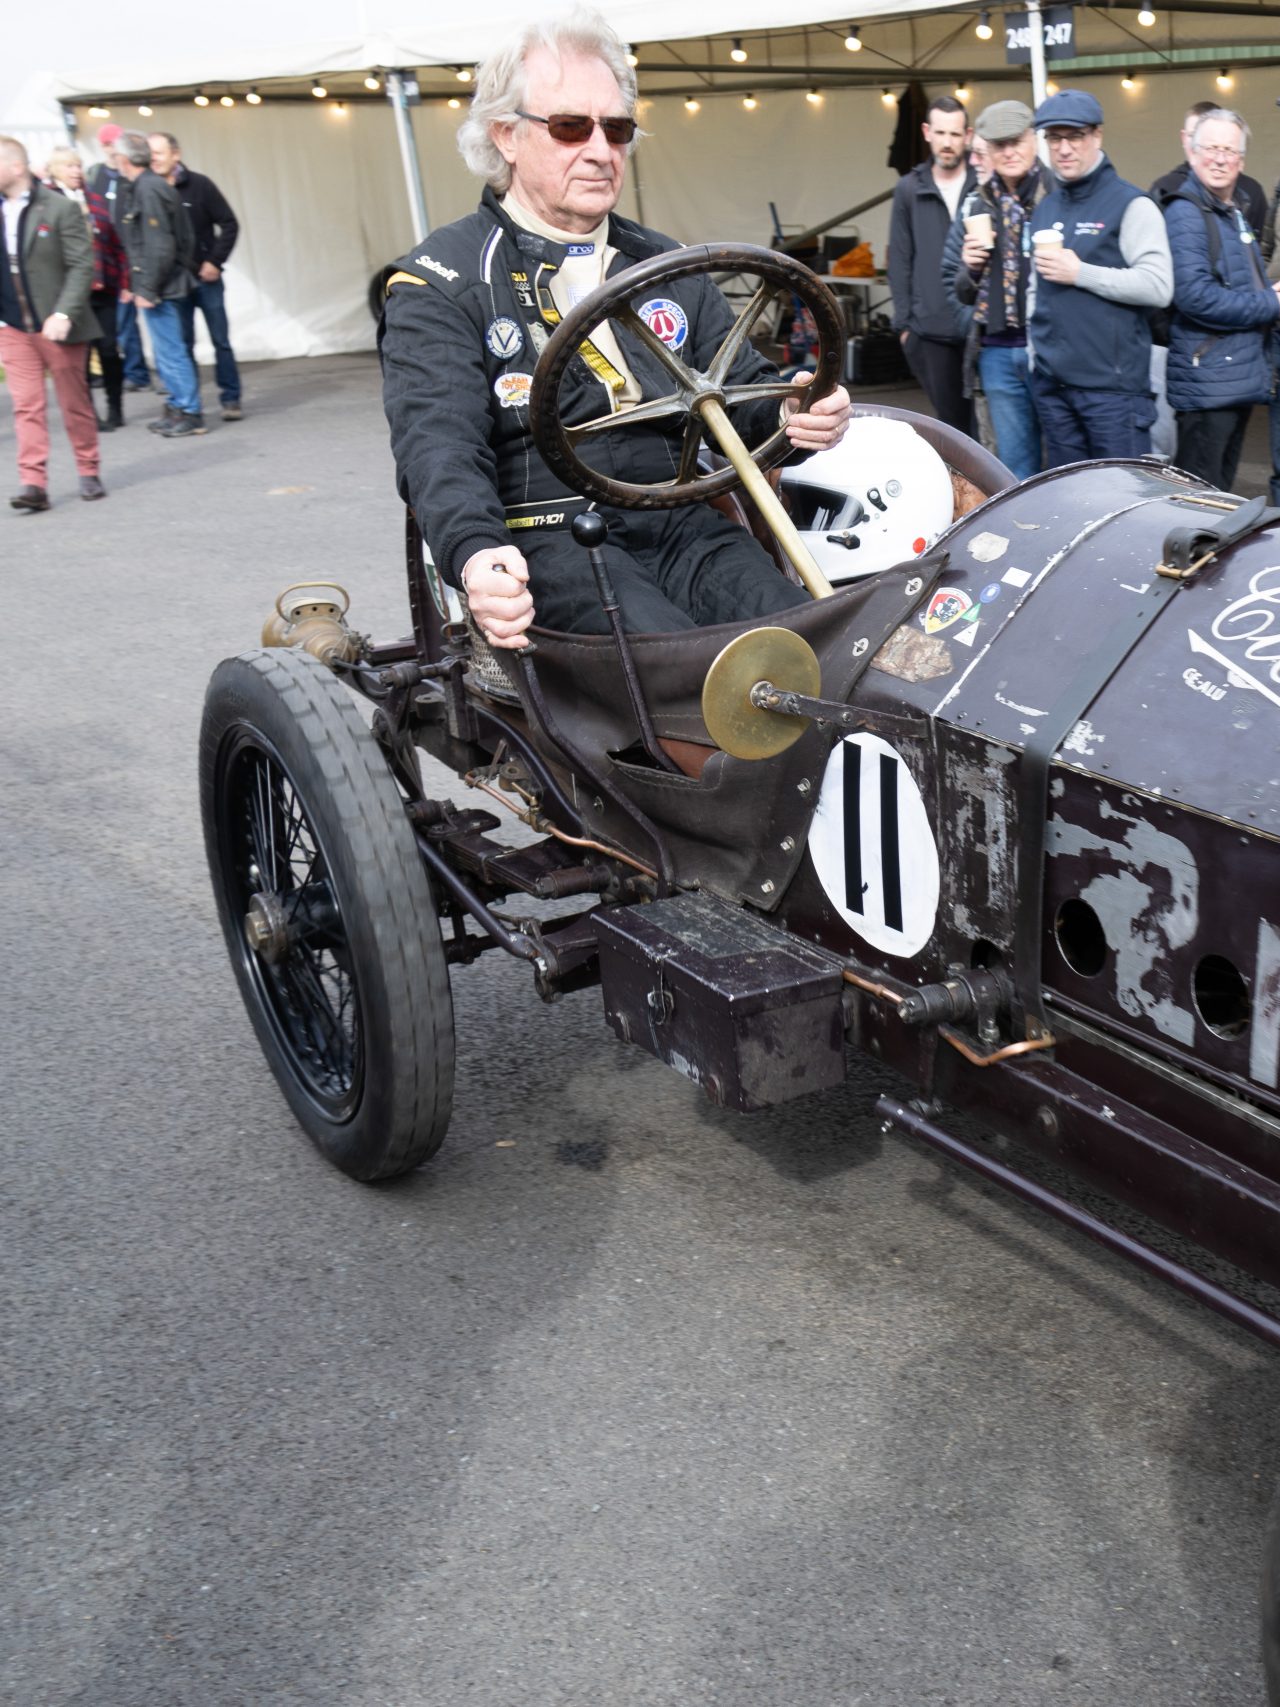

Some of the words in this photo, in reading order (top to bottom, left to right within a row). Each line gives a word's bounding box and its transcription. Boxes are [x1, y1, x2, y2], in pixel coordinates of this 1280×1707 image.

[1043, 23, 1072, 45] 247
[569, 246, 594, 254] arco
[415, 255, 460, 282] Sabelt
[843, 739, 903, 933] 11
